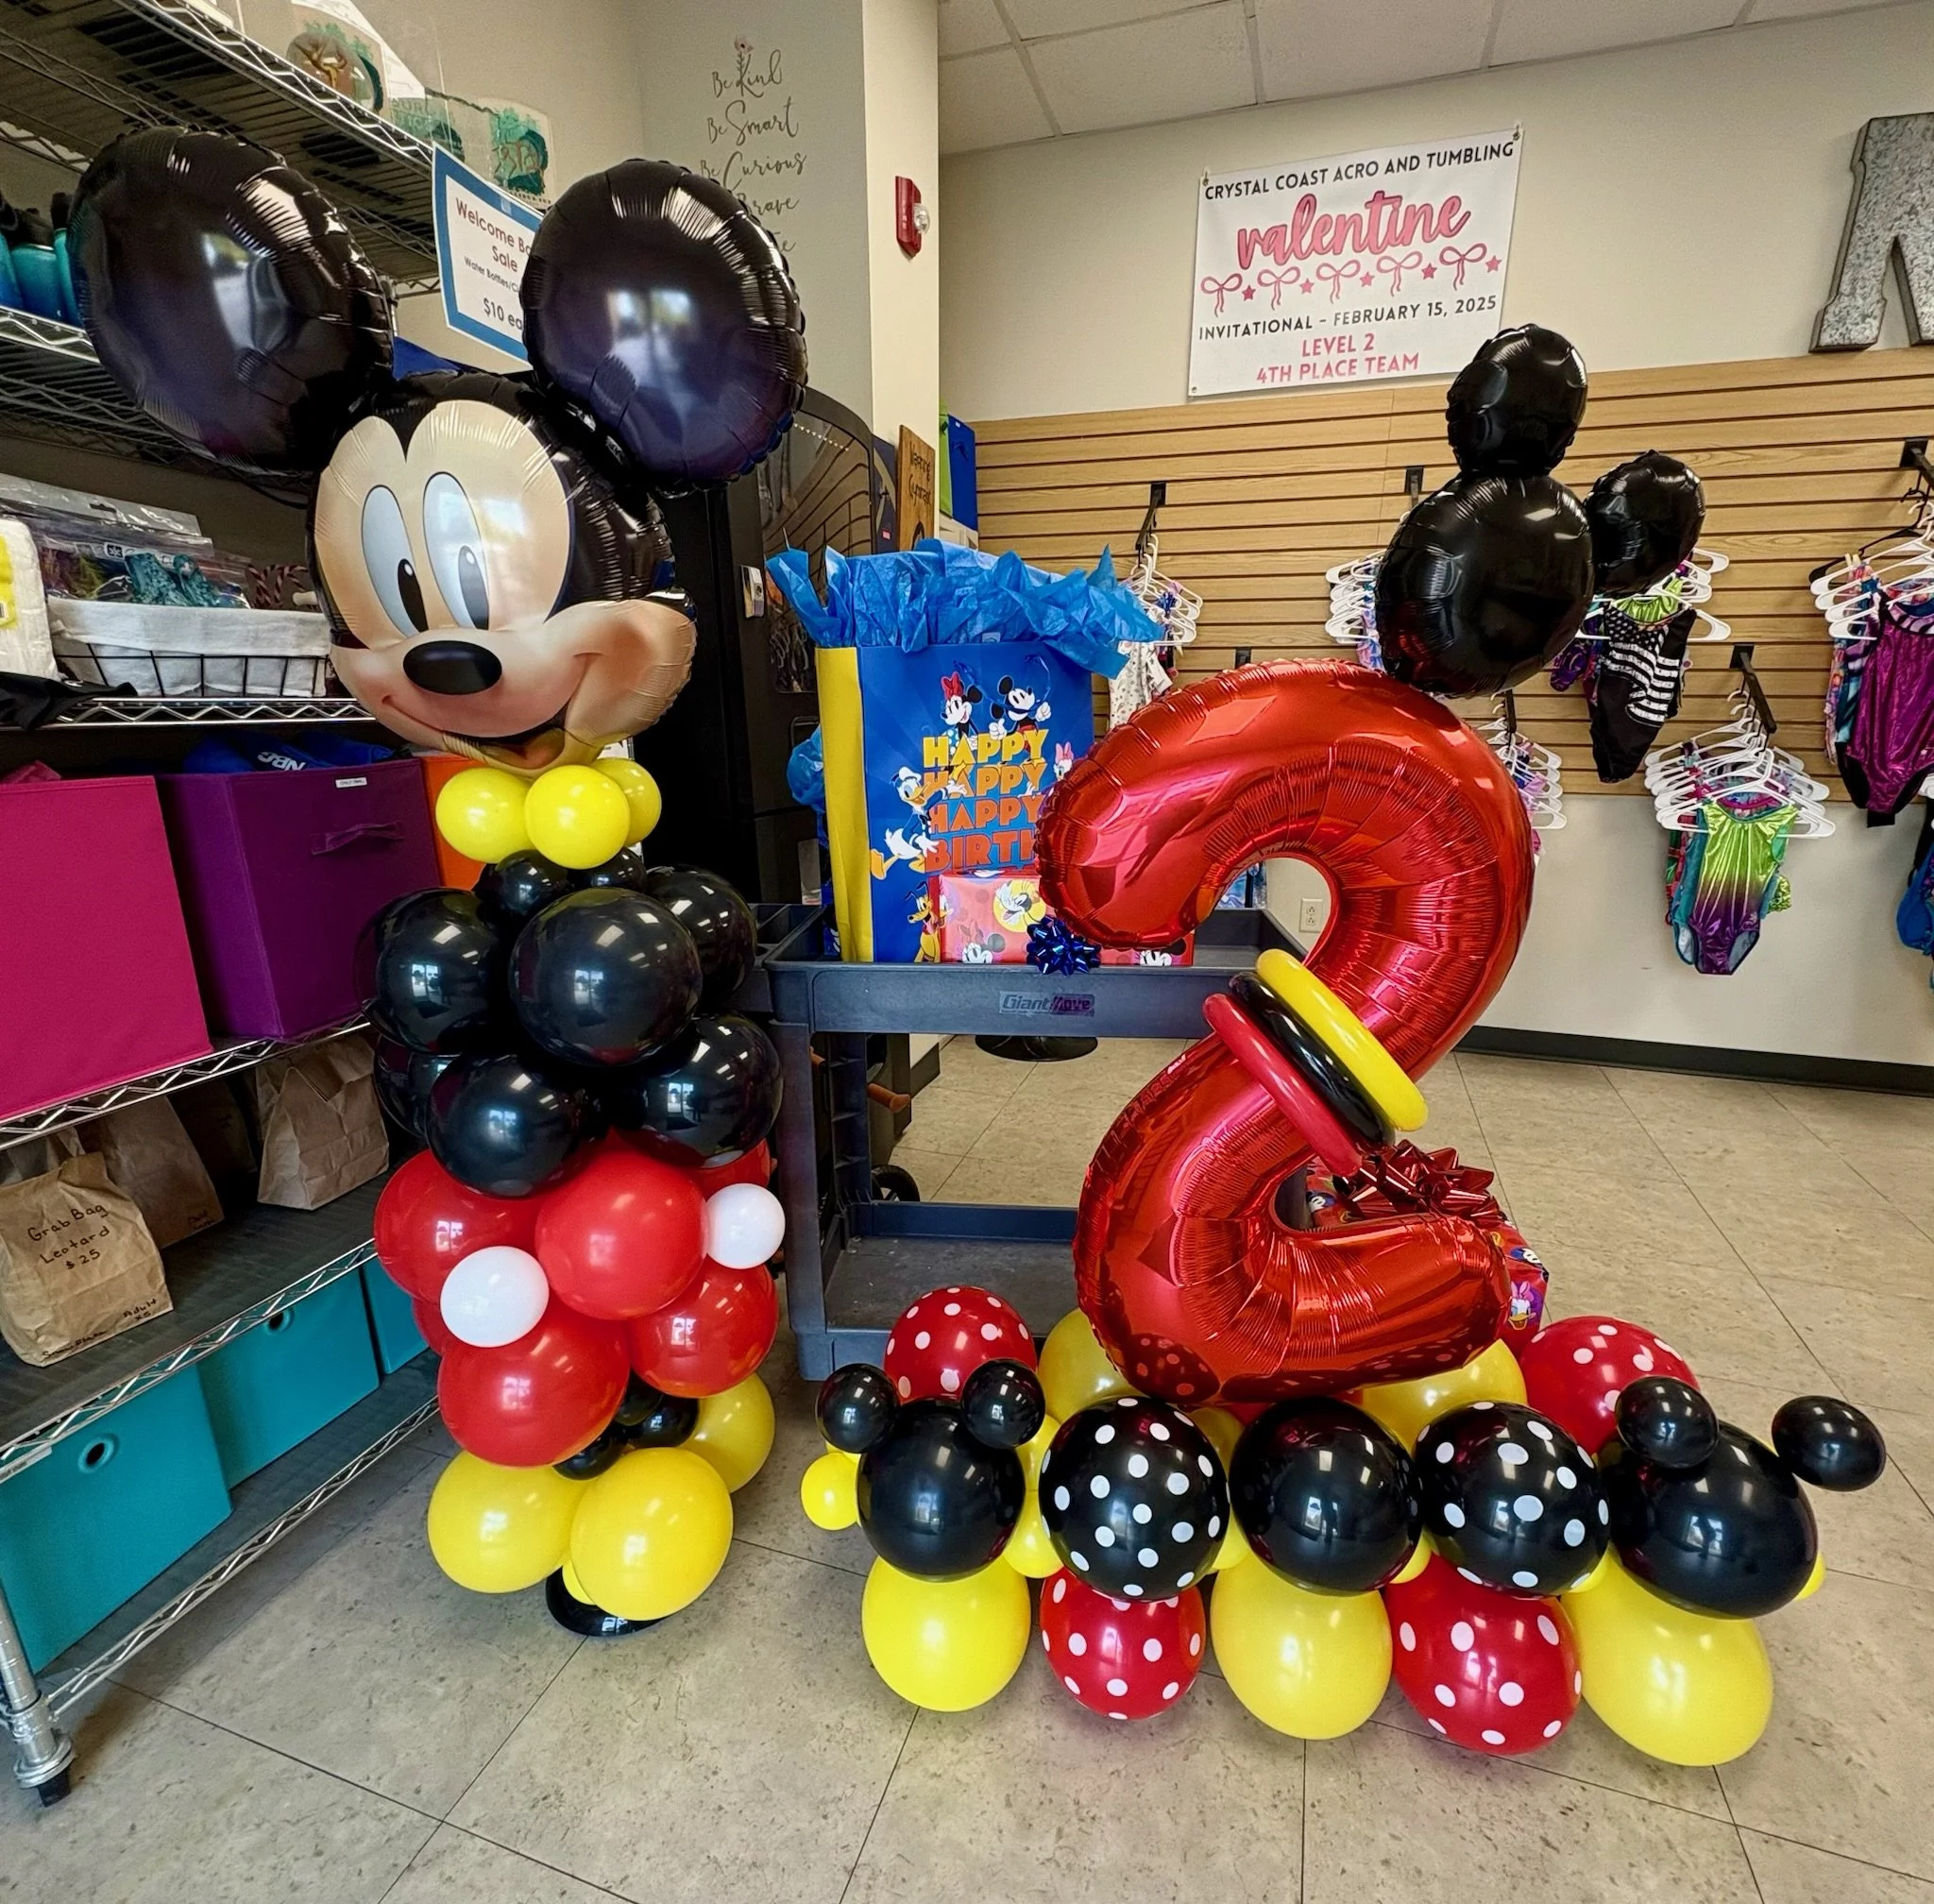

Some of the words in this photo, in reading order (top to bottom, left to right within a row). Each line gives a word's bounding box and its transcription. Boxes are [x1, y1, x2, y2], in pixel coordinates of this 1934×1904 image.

[711, 71, 733, 98] Be
[736, 49, 782, 98] Kind
[707, 116, 728, 144] Be
[725, 95, 799, 146] Smart
[723, 151, 807, 191] Curious
[1205, 178, 1269, 199] CRYSTAL
[1275, 168, 1328, 190] COAST
[1332, 161, 1379, 182] ACRO
[1384, 155, 1420, 175] AND
[1427, 142, 1514, 168] TUMBLING
[456, 197, 515, 247] Welcome
[1237, 190, 1471, 270] valentine
[465, 256, 485, 276] Water
[492, 246, 518, 272] Sale
[484, 297, 504, 321] $10
[1199, 315, 1313, 340] INVITATIONAL
[1333, 303, 1420, 326] FEBRUARY
[1428, 301, 1448, 317] 15,
[1455, 295, 1497, 314] 2025
[1302, 334, 1356, 357] LEVEL
[1363, 332, 1375, 352] 2
[1256, 365, 1292, 383] 4TH
[1299, 358, 1358, 381] PLACE
[1365, 352, 1419, 375] TEAM
[923, 729, 1049, 767] HAPPY
[923, 763, 1047, 801] HAPPY
[928, 794, 1045, 833] HAPPY
[27, 1219, 71, 1241] Grab
[70, 1204, 110, 1220] Bag
[40, 1226, 110, 1264] Leotard
[123, 1298, 157, 1318] Adult
